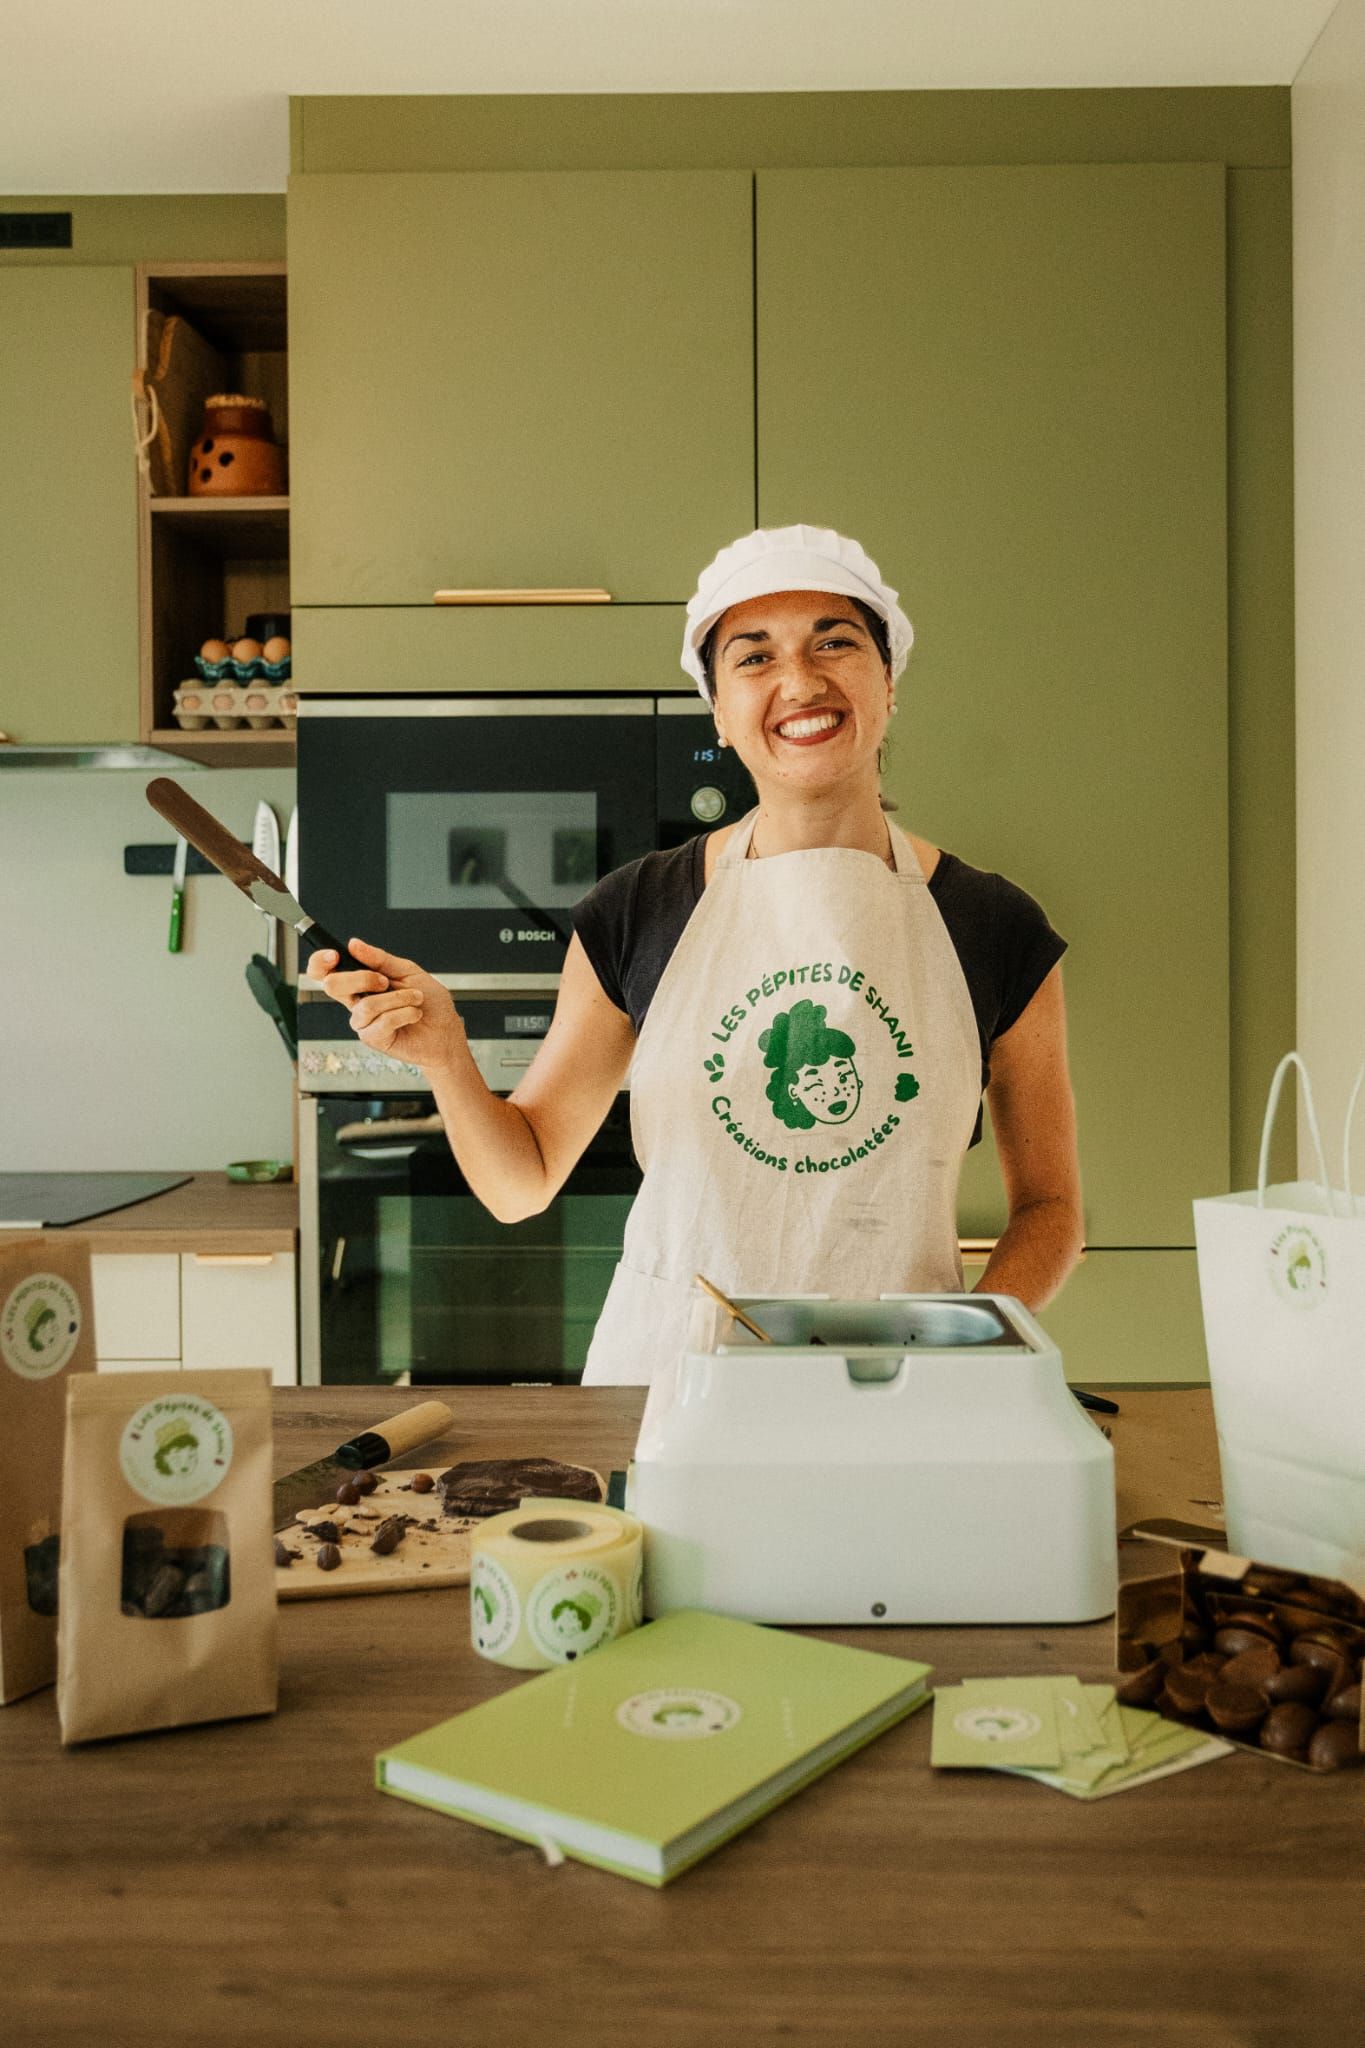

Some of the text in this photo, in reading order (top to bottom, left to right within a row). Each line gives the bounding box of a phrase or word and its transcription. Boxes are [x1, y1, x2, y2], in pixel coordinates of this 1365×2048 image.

[517, 930, 556, 941] BOSCH
[712, 962, 914, 1058] LES PÉPITES DE SHANI
[711, 1096, 901, 1174] Créations chocolatées
